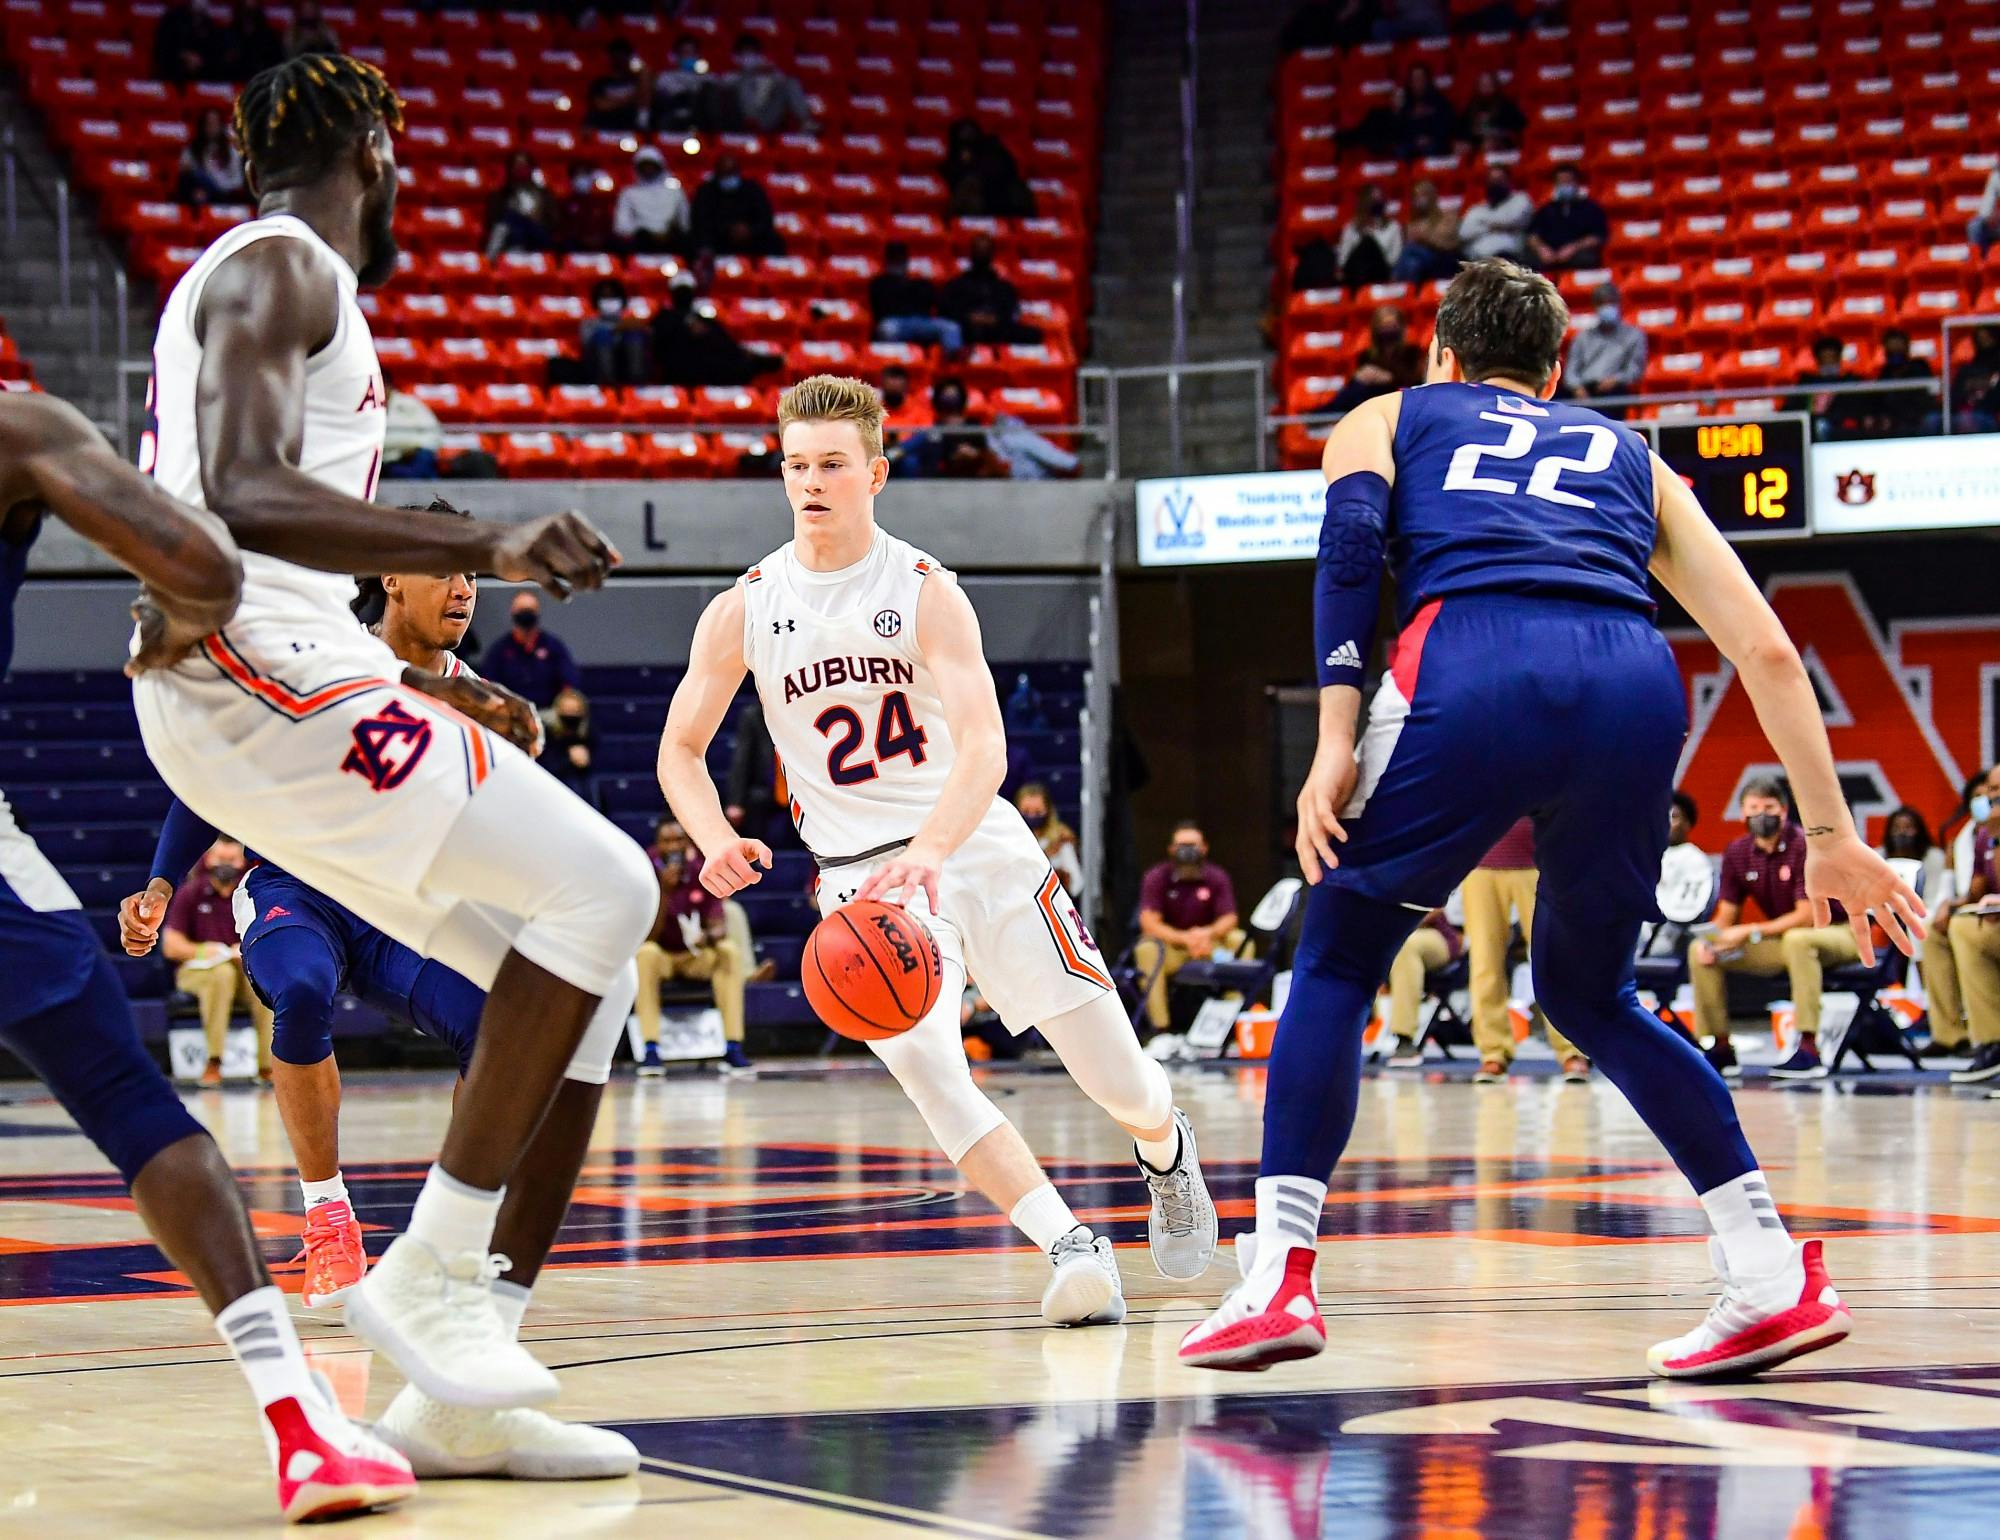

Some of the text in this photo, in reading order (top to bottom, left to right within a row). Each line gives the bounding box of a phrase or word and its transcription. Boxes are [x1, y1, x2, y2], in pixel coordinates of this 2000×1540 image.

[1442, 411, 1619, 509] 22
[1697, 424, 1763, 459] USA
[1743, 467, 1788, 519] 12
[644, 501, 668, 551] L
[1216, 514, 1276, 528] Medical
[874, 610, 901, 637] SEC
[783, 656, 914, 704] AUBURN
[814, 690, 928, 787] 24
[870, 914, 919, 974] NCAA
